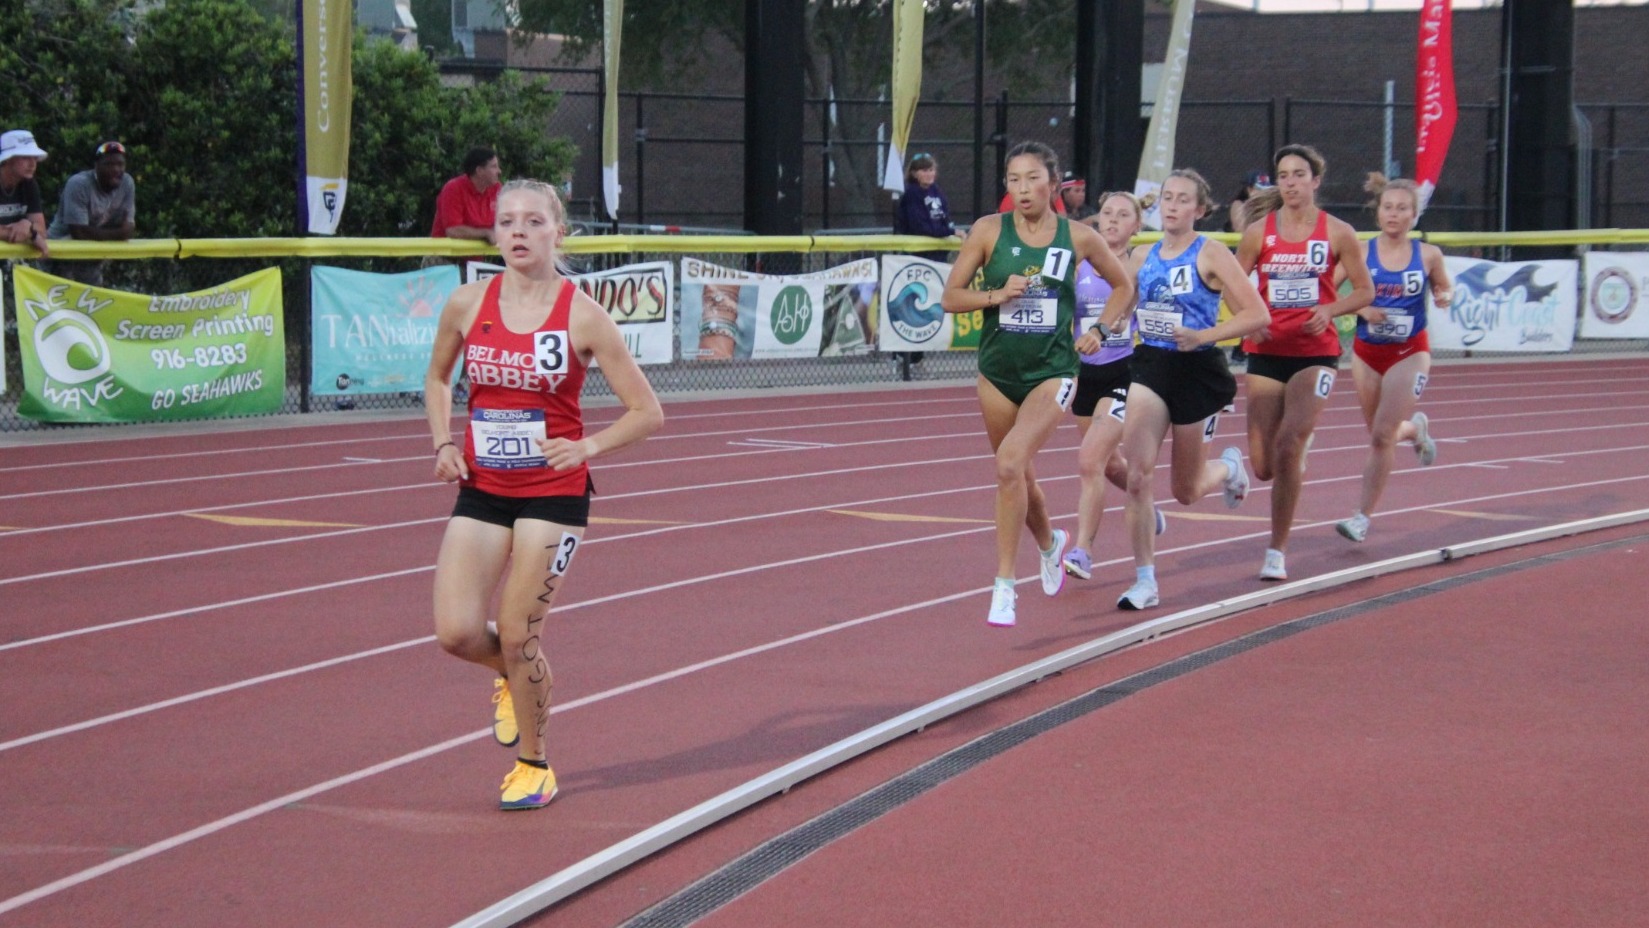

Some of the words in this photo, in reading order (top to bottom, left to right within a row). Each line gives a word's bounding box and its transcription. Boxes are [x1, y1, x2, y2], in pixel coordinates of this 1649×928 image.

[1050, 250, 1064, 277] 1
[1271, 253, 1309, 263] NORT
[1311, 242, 1325, 266] 6
[906, 269, 932, 281] FPC
[1172, 267, 1189, 292] 4
[1407, 273, 1420, 294] 5
[24, 284, 114, 321] NEW
[149, 288, 252, 313] Embroidery
[1275, 288, 1312, 301] 505
[115, 319, 186, 340] Screen
[191, 314, 275, 336] Printing
[1011, 309, 1044, 324] 413
[1450, 287, 1509, 347] Right
[898, 323, 913, 338] THE
[914, 324, 938, 339] WAVE
[151, 343, 248, 369] 916-8283
[467, 344, 536, 369] BELMO
[539, 334, 564, 371] 3
[151, 390, 176, 411] GO
[181, 369, 263, 406] SEAHAWKS
[467, 361, 568, 395] ABBEY
[1318, 373, 1333, 396] 6
[43, 375, 124, 410] WAVE
[1204, 415, 1217, 438] 4
[486, 436, 530, 456] 201
[556, 536, 576, 573] 3
